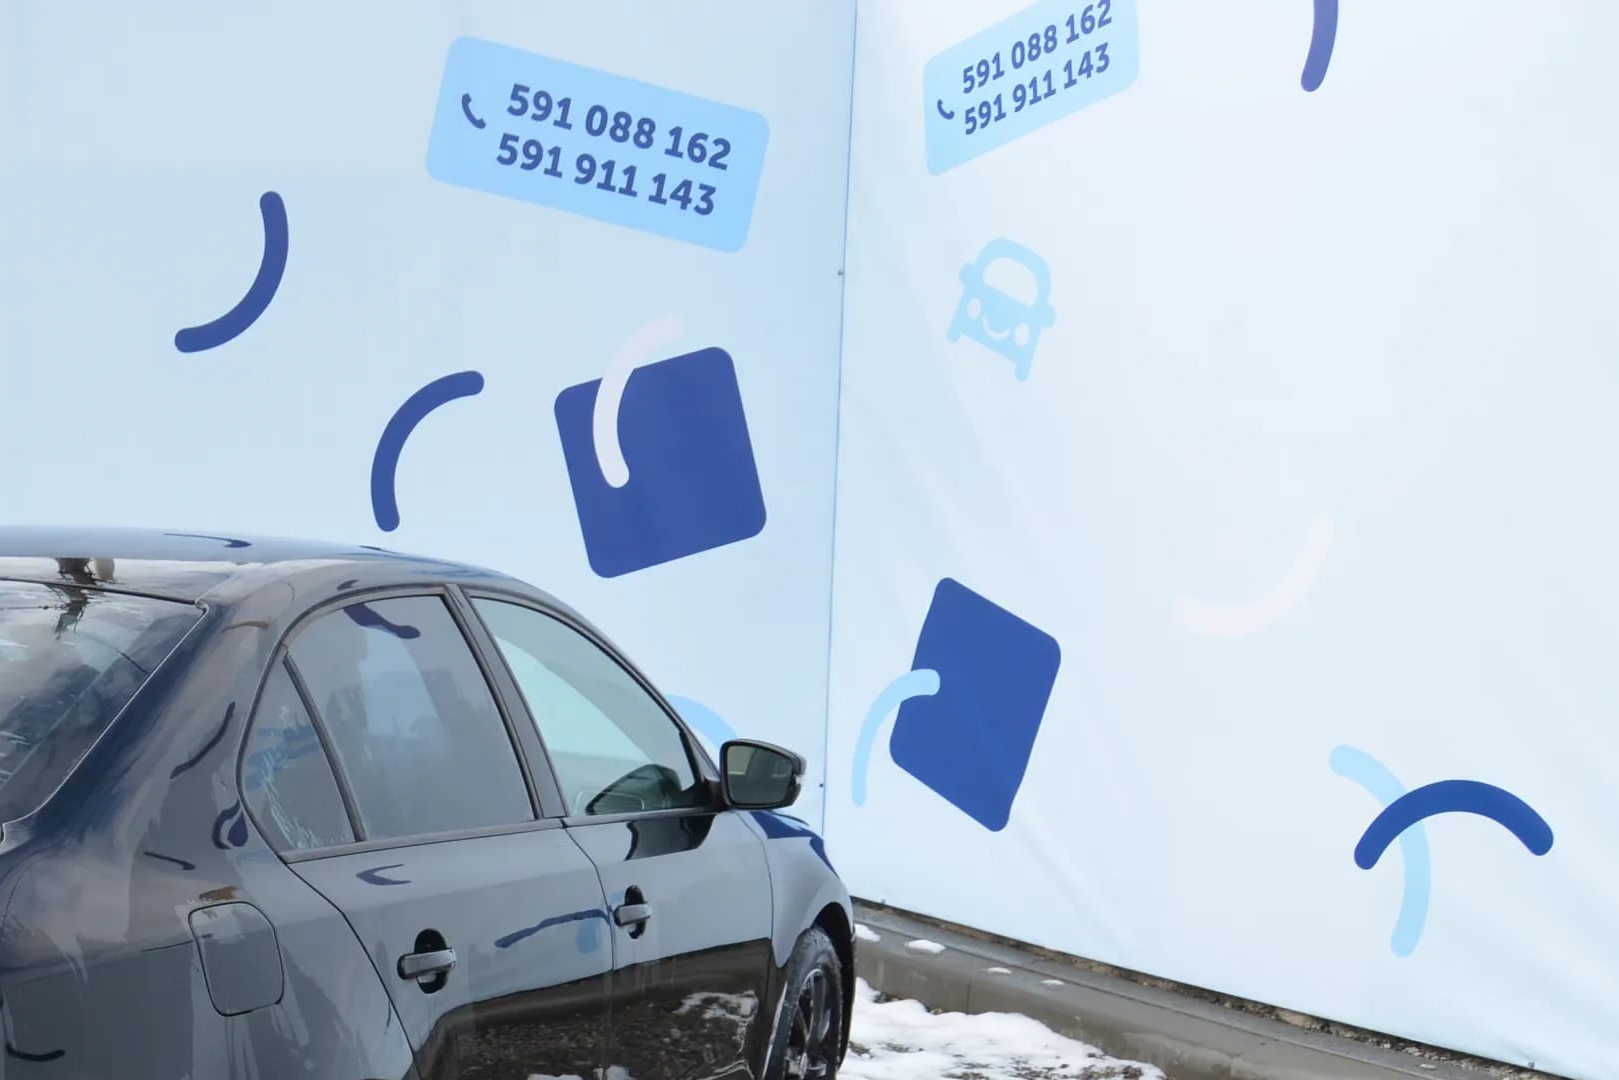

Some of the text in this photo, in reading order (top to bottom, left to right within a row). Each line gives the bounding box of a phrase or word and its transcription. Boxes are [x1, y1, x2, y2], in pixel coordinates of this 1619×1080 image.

[962, 0, 1113, 94] 591 088 162
[964, 42, 1110, 136] 591 911 143
[507, 83, 731, 171] 591 088 162
[496, 132, 717, 216] 591 911 143
